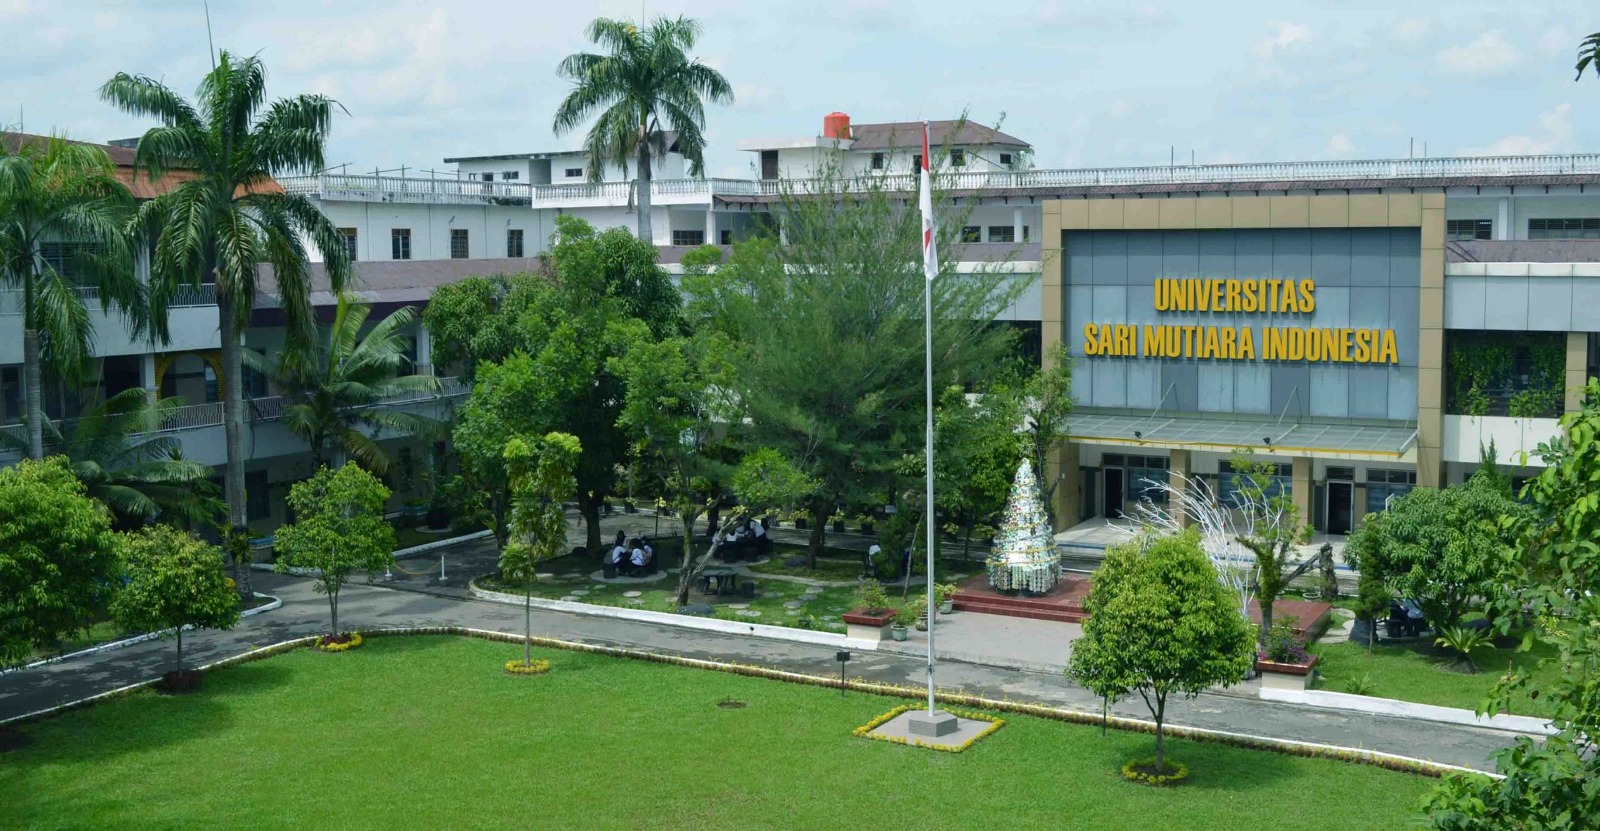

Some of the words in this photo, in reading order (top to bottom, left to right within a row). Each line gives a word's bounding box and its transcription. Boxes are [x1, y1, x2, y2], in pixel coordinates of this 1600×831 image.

[1154, 278, 1316, 313] UNIVERSITAS
[1083, 323, 1137, 357] SARI
[1143, 324, 1255, 360] MUTIARA
[1261, 326, 1398, 364] INDONESIA
